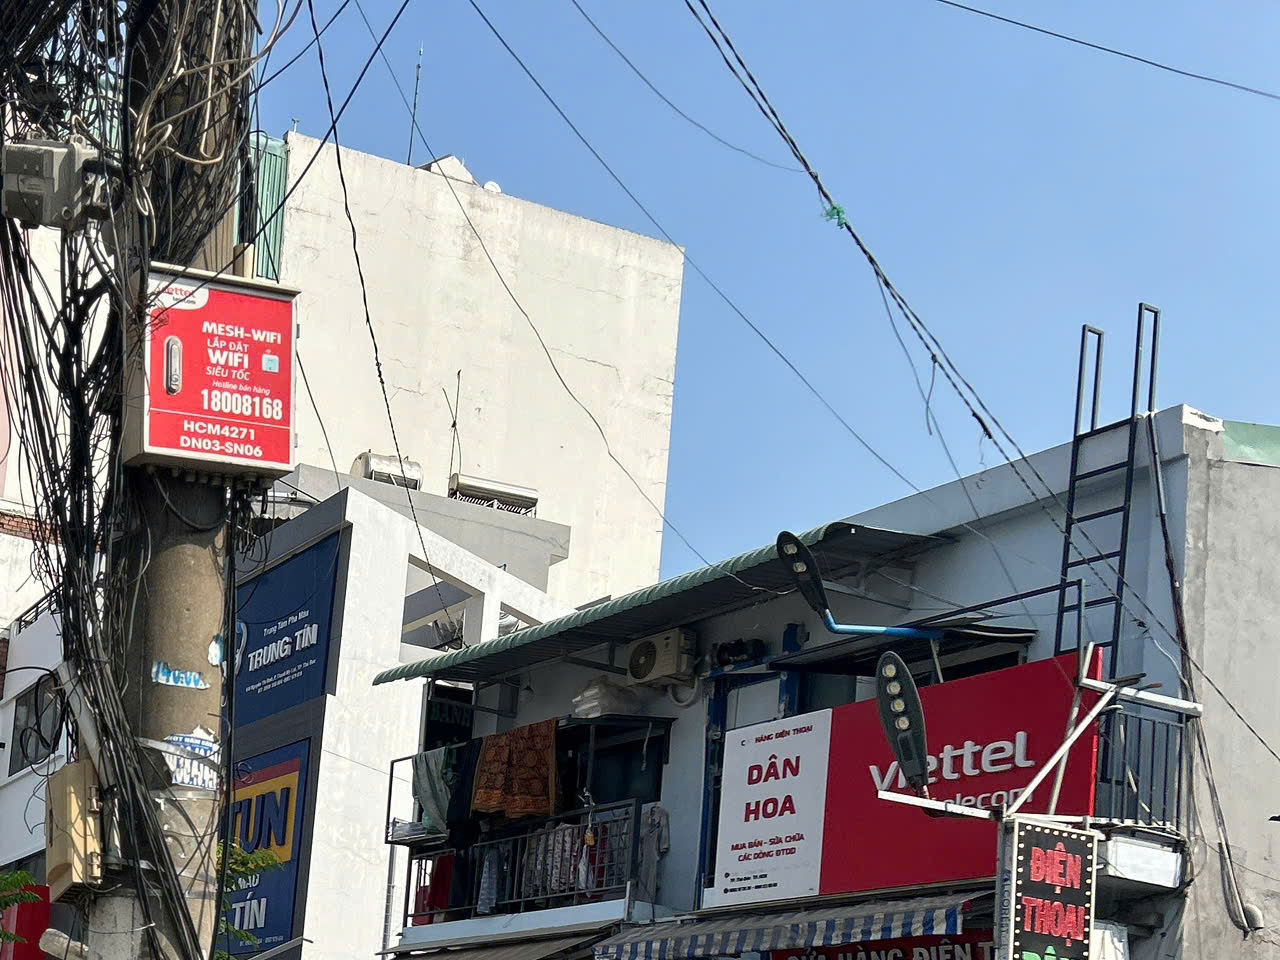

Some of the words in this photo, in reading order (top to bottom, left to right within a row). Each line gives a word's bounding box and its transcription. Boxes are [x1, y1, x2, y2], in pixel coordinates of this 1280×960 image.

[202, 321, 282, 344] MESH-WIFI
[207, 336, 226, 348] LẮP
[228, 341, 249, 353] ĐẶT
[207, 348, 249, 369] WIFI
[206, 364, 229, 378] SIÊU
[231, 366, 251, 381] TỐC
[212, 380, 238, 390] Hotline
[253, 385, 271, 396] hàng
[201, 389, 283, 420] 18008168
[183, 419, 255, 440] HCM4271
[180, 435, 263, 457] DN03-SN06
[248, 636, 293, 672] TRUNG
[294, 623, 319, 651] TÍN
[792, 724, 813, 736] THOẠI
[747, 753, 801, 785] DÂN
[744, 794, 796, 822] HOA
[932, 788, 1033, 810] elecom
[731, 841, 746, 851] MUA
[748, 838, 763, 849] BÁN
[768, 835, 783, 846] SỬA
[785, 832, 805, 843] CHỮA
[738, 852, 752, 862] CÁC
[1029, 841, 1083, 893] ĐIỆN
[231, 891, 267, 931] TÍN
[1022, 895, 1085, 946] THOẠI
